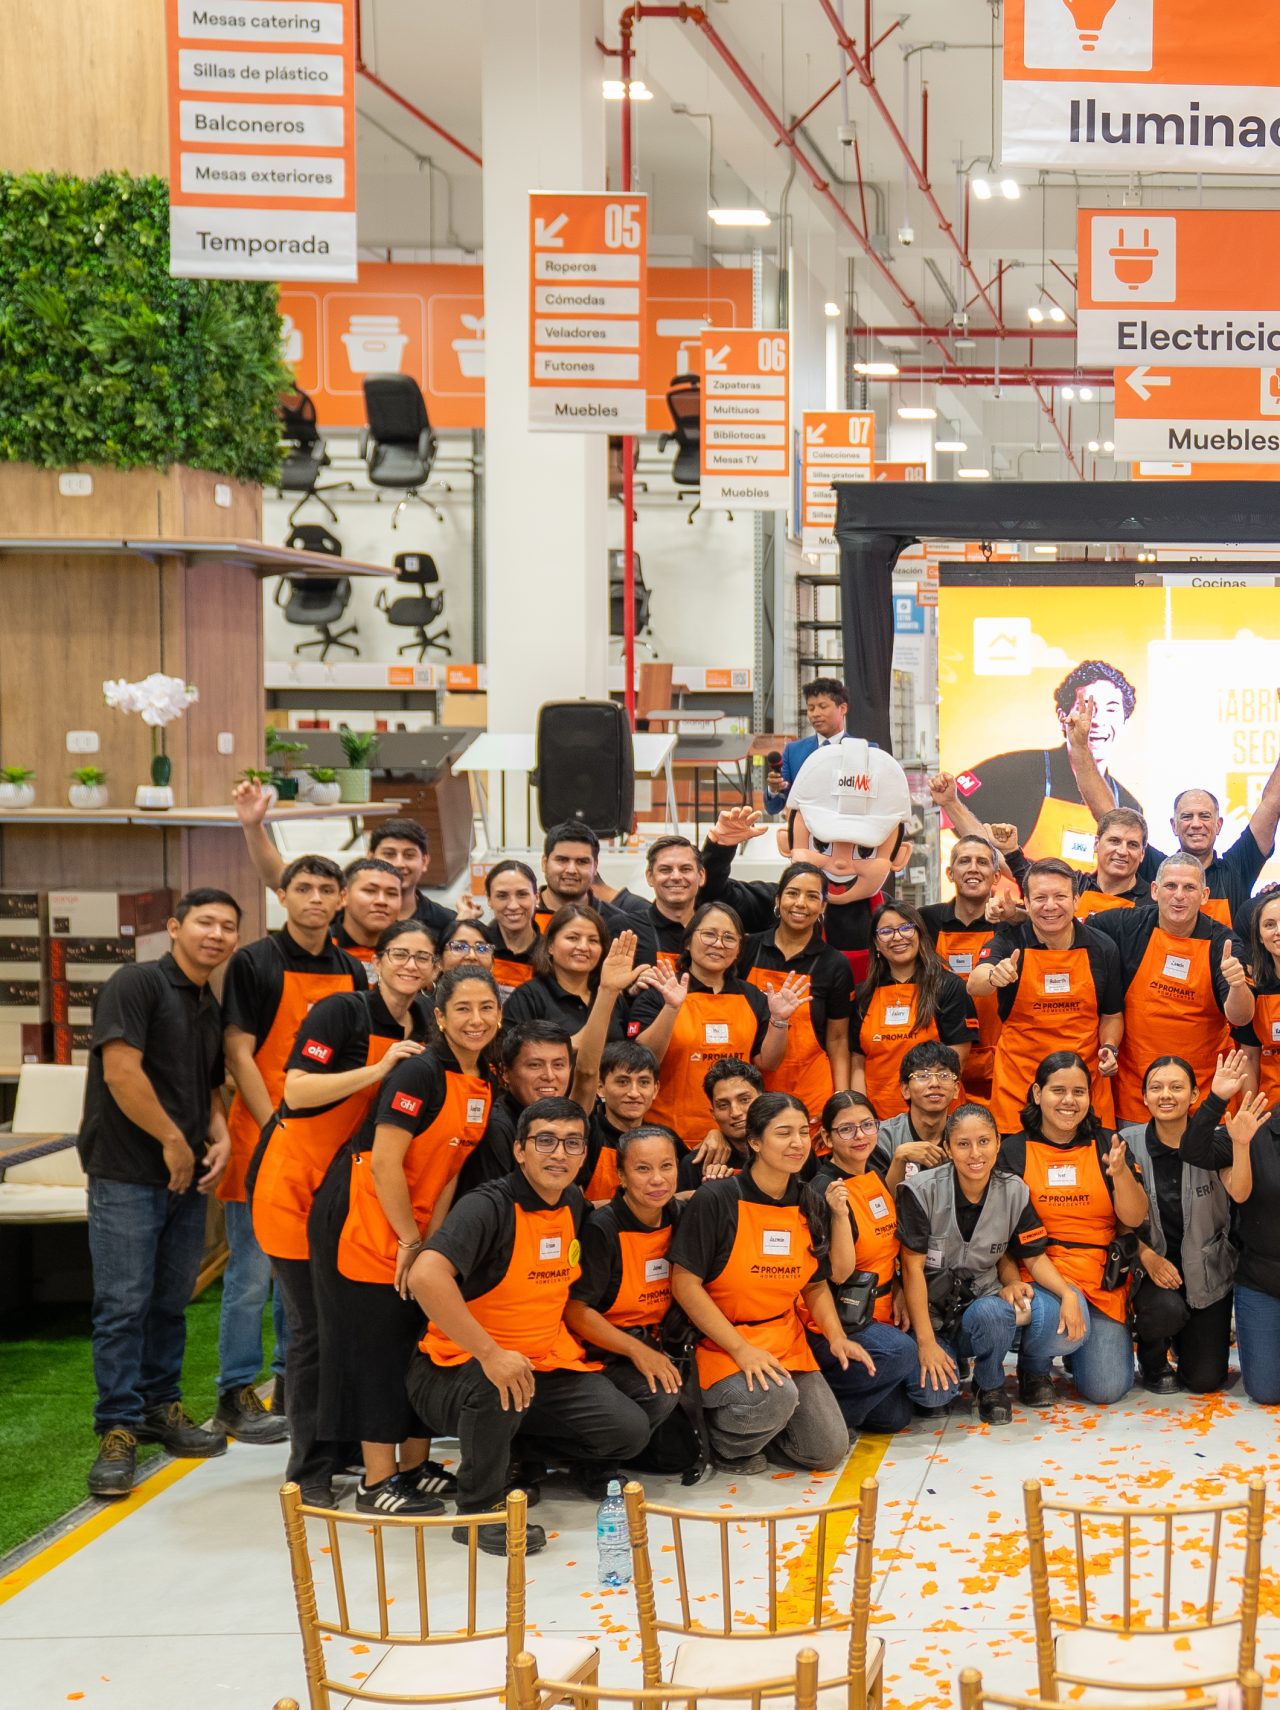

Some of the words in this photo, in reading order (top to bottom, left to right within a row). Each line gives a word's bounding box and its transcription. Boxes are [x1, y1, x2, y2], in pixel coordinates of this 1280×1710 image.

[193, 11, 246, 27] Mesas
[251, 15, 321, 32] catering
[193, 63, 236, 79] Sillas
[240, 65, 260, 79] de
[265, 66, 329, 83] plástico
[195, 114, 305, 133] Balconeros
[196, 167, 247, 182] Mesas
[251, 169, 333, 184] exteriores
[605, 204, 640, 248] 05
[197, 231, 330, 256] Temporada
[545, 260, 597, 275] Roperos
[545, 294, 605, 305] Cómodas
[545, 327, 606, 339] Veladores
[758, 338, 786, 371] 06
[544, 360, 595, 371] Futones
[713, 381, 761, 390] Zapateras
[555, 403, 618, 417] Muebles
[713, 406, 760, 415] Multiusos
[713, 430, 766, 440] Bibliotecas
[848, 417, 870, 444] 07
[1168, 428, 1280, 451] Muebles
[713, 456, 743, 464] Mesas
[745, 456, 758, 464] TV
[721, 488, 769, 498] Muebles
[1158, 983, 1196, 997] PROMART
[1042, 1001, 1081, 1009] PROMART
[881, 1033, 918, 1041] PROMART
[308, 1046, 327, 1058] oh!
[702, 1053, 744, 1061] PROMART
[400, 1099, 416, 1112] oh!
[1049, 1194, 1090, 1203] PROMART
[536, 1268, 571, 1280] PROMART
[760, 1266, 802, 1274] PROMART
